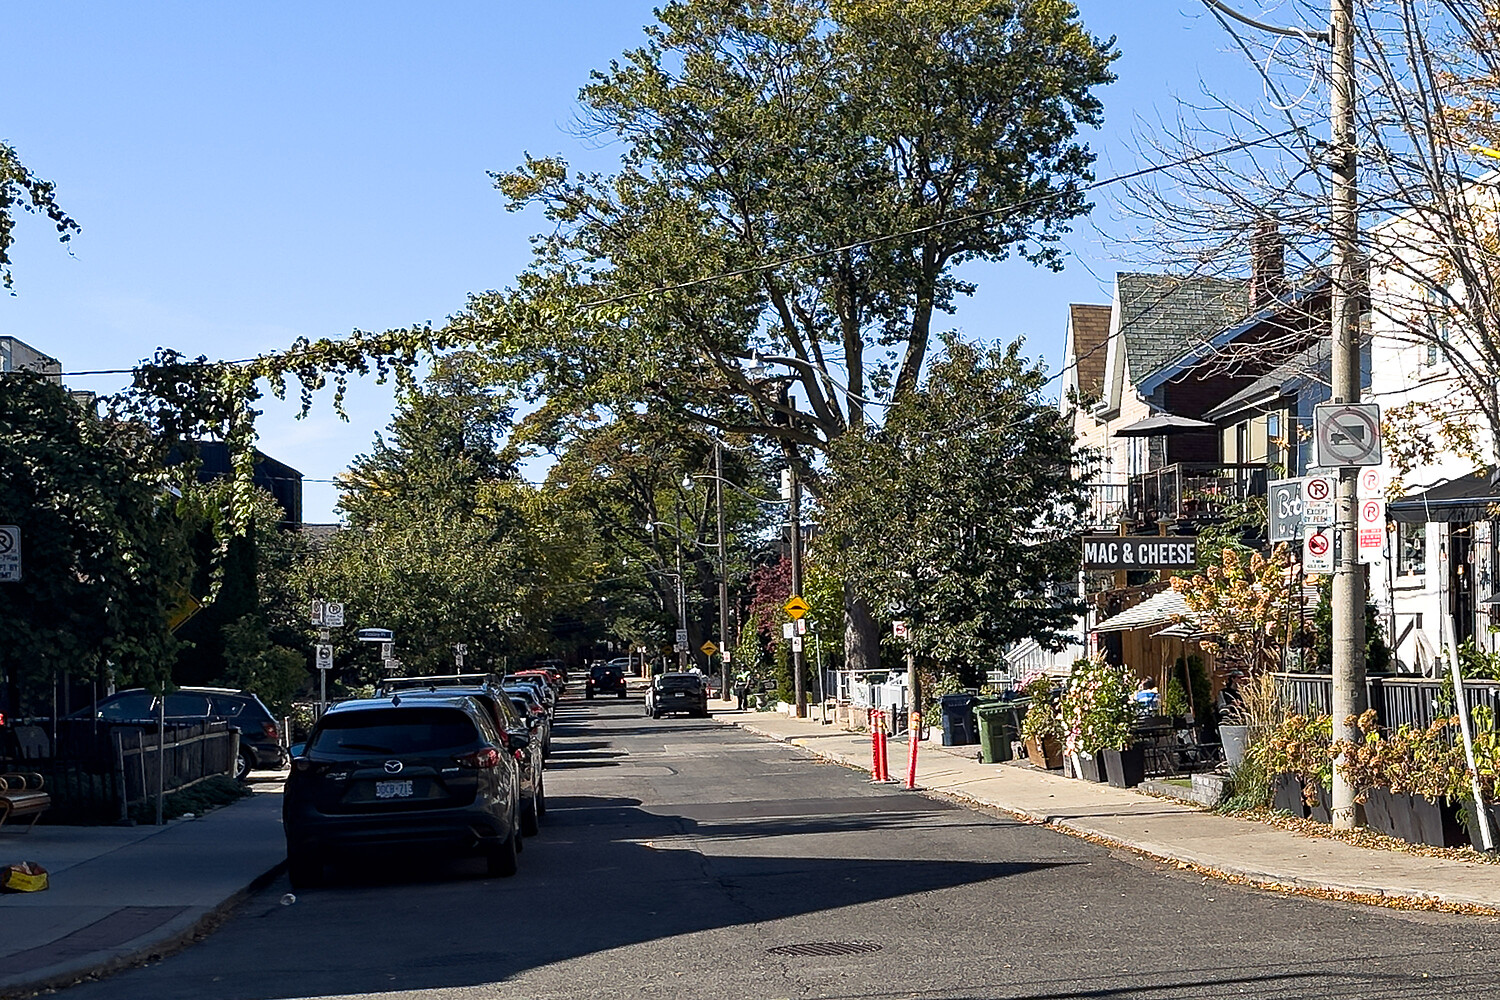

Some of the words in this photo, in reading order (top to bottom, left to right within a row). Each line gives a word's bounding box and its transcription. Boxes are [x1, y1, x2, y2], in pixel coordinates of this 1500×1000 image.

[1084, 543, 1118, 564] MAC
[1122, 543, 1134, 564] &
[1138, 543, 1195, 565] CHEESE
